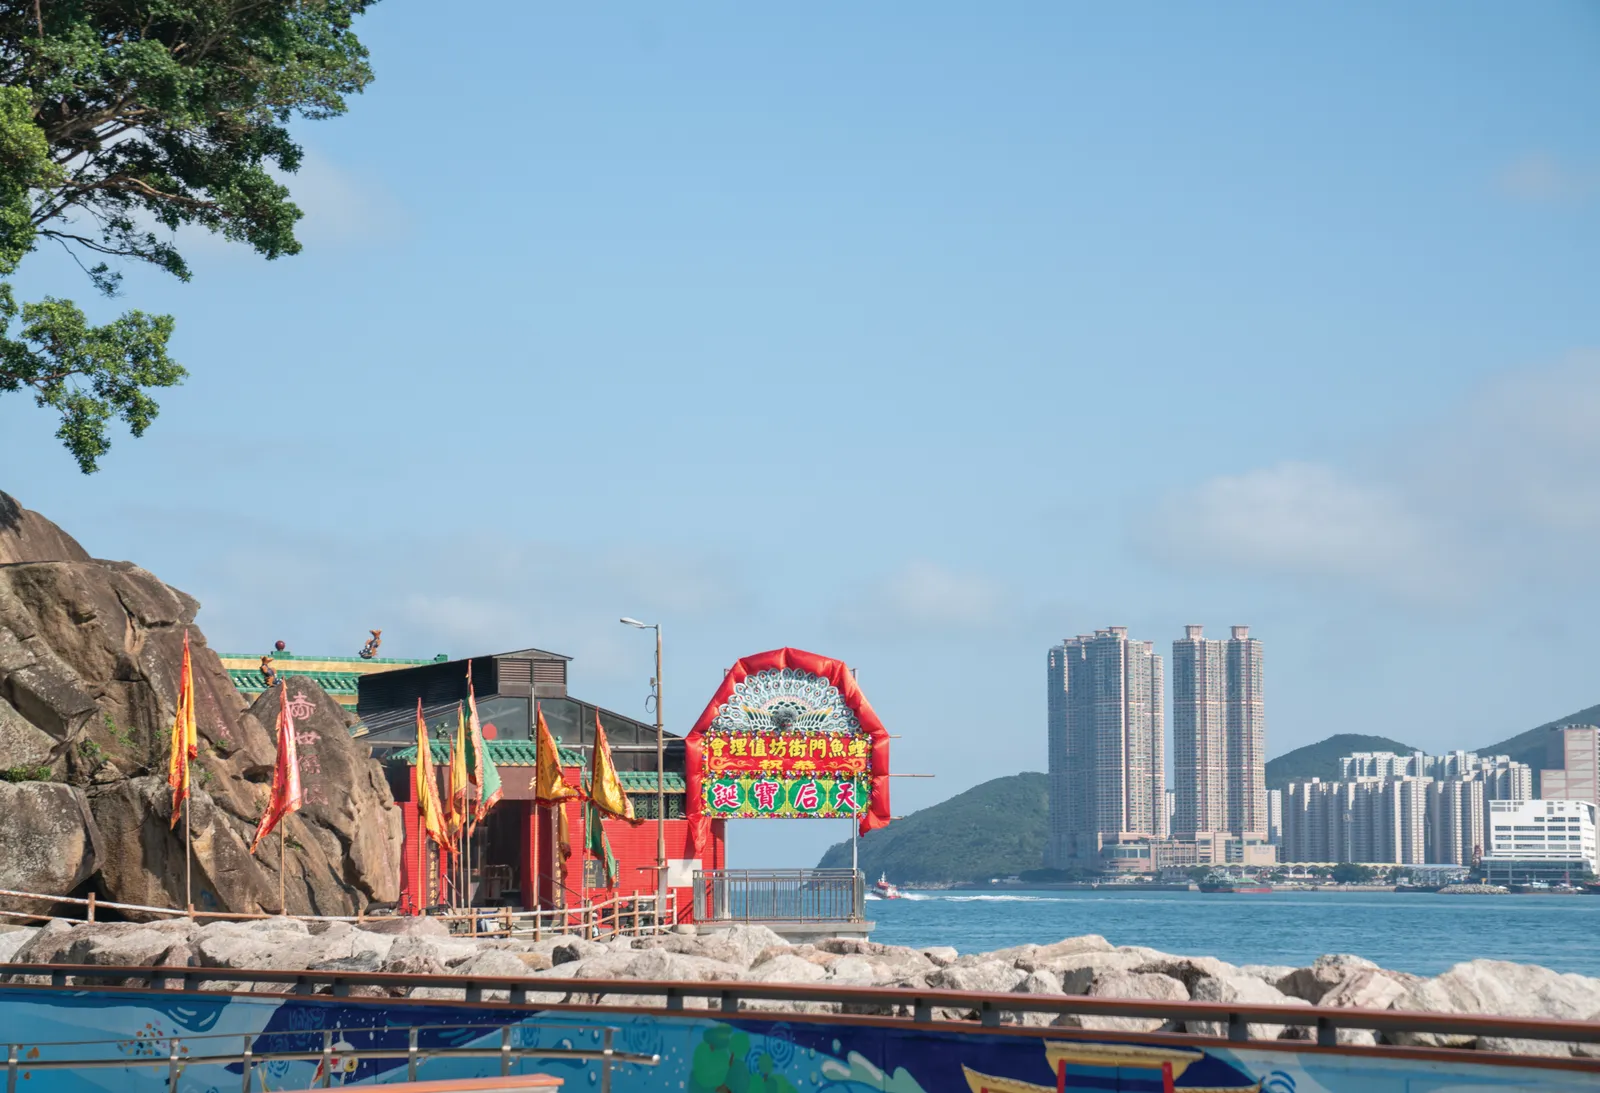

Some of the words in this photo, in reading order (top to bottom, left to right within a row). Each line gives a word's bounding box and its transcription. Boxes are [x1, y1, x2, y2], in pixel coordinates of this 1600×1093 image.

[710, 738, 866, 758] 鯉魚門街坊值理會
[759, 760, 816, 771] 恭祝
[712, 781, 861, 811] 天后寶誕
